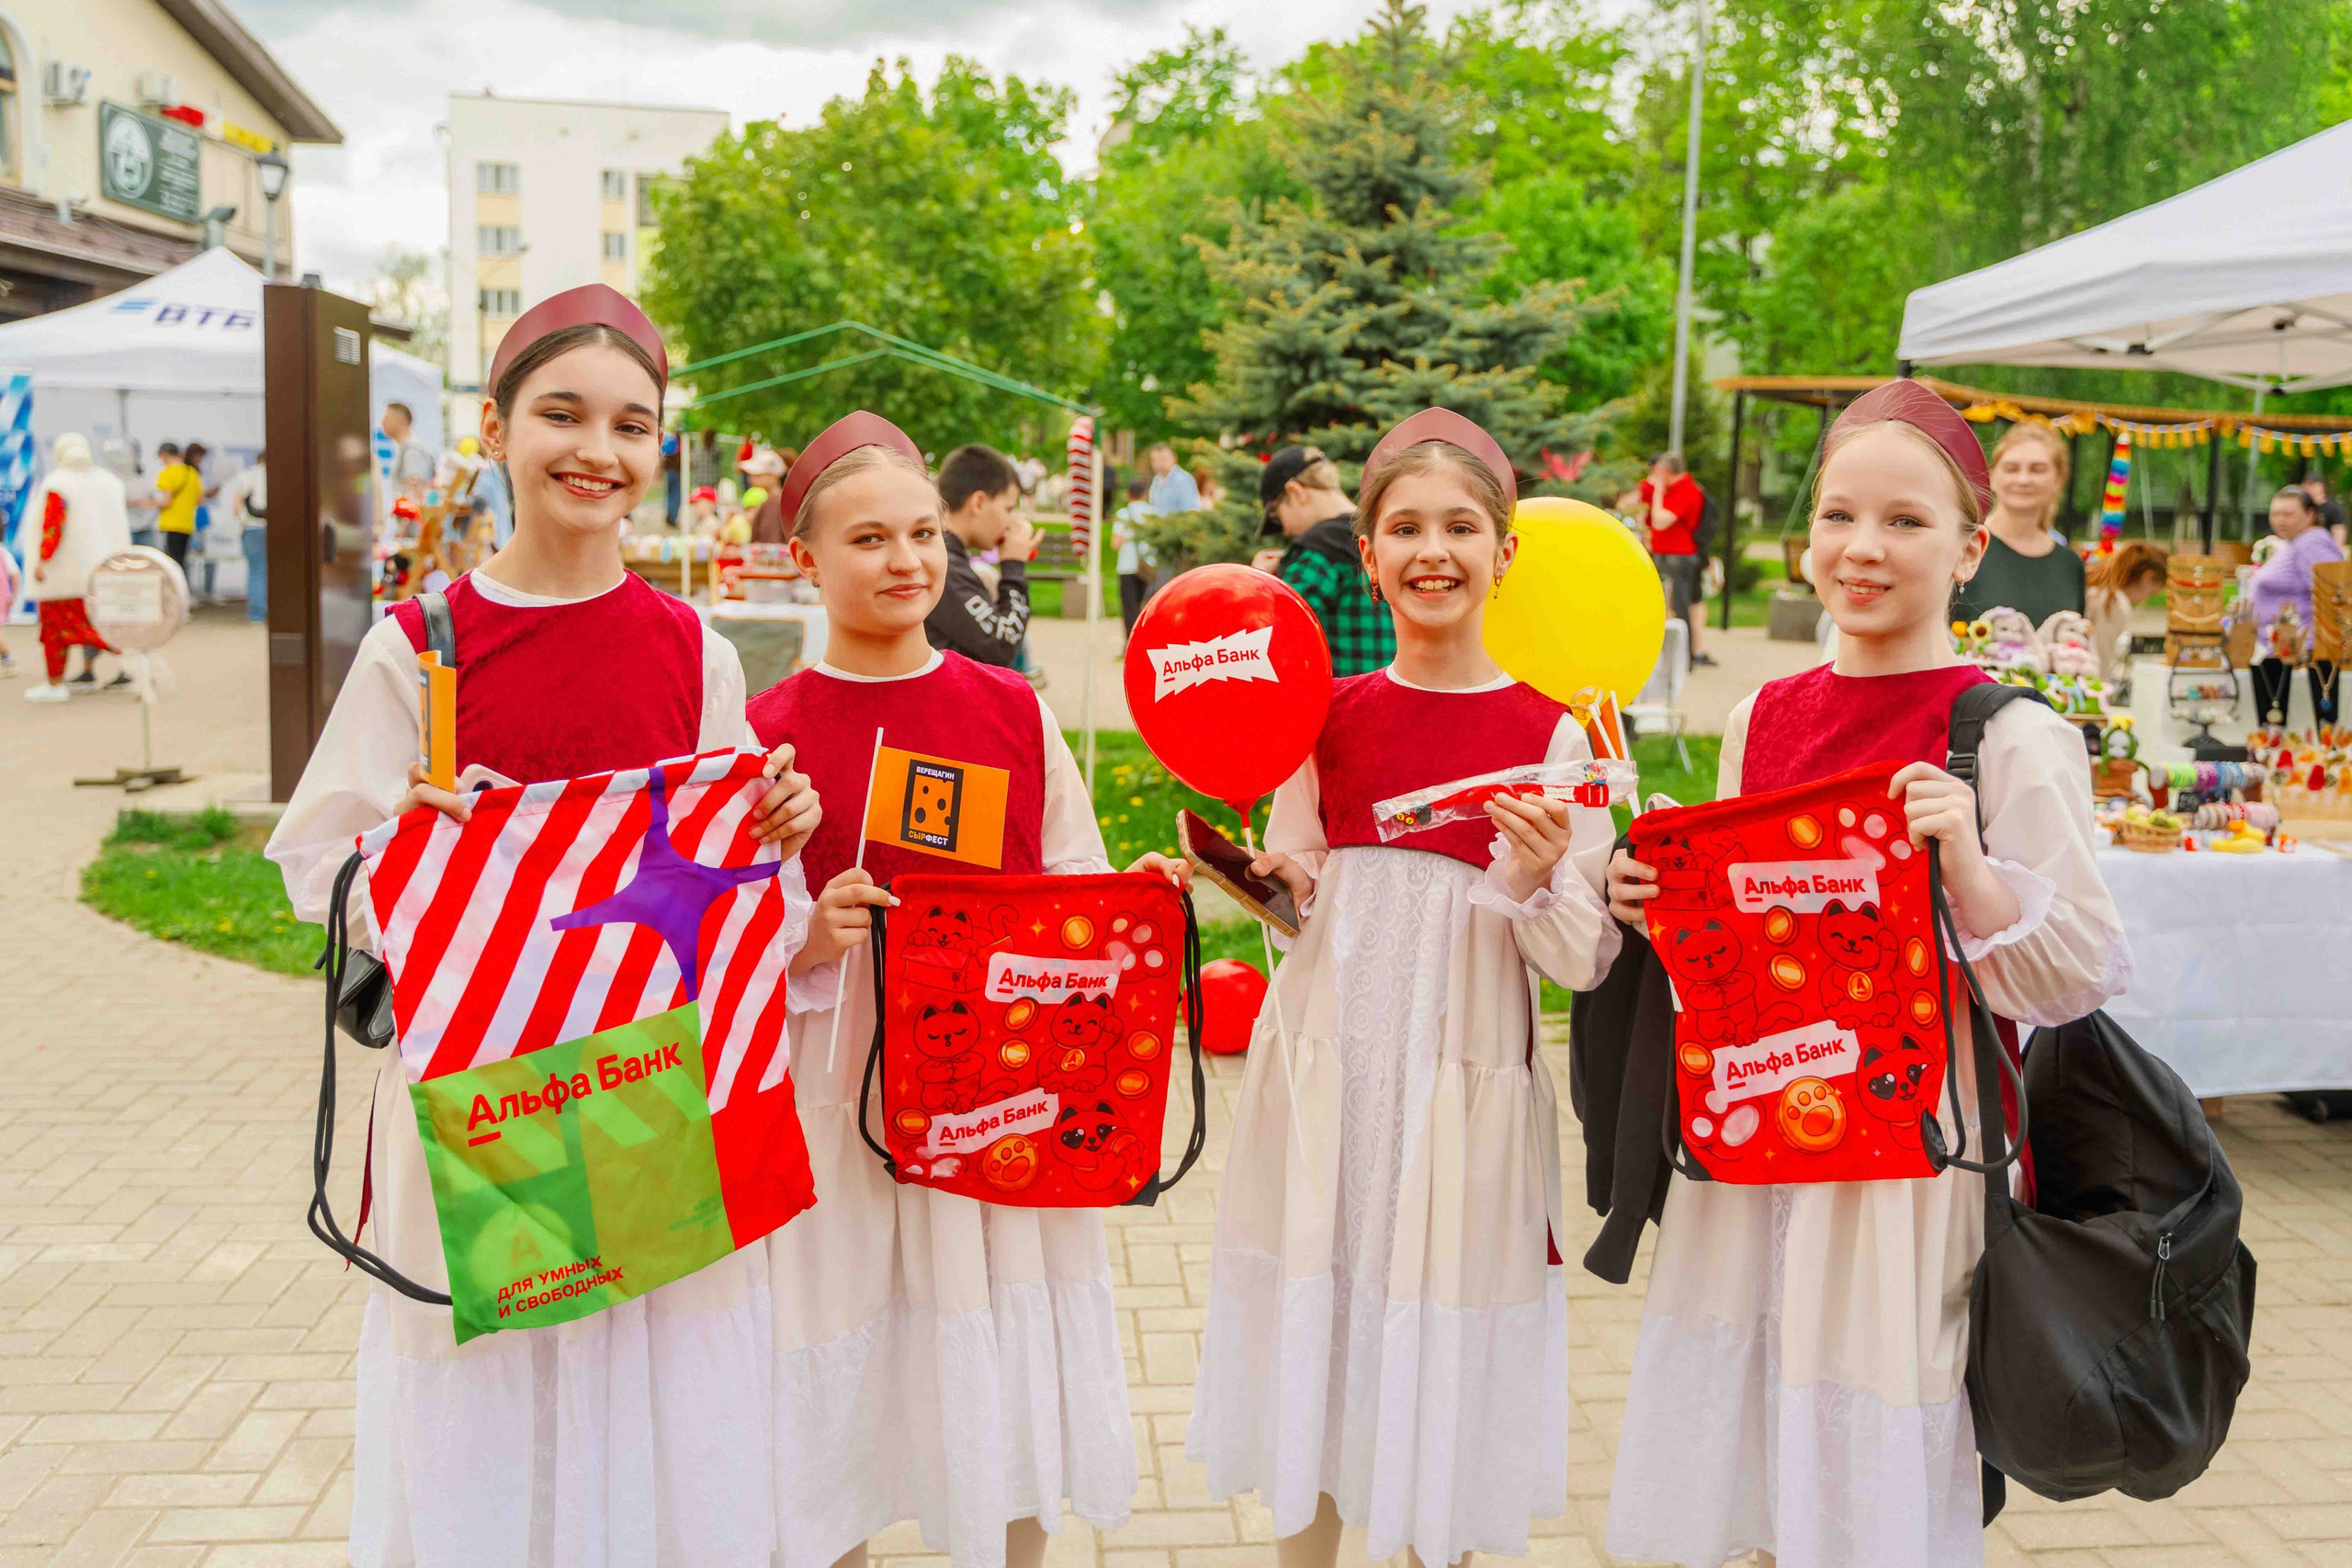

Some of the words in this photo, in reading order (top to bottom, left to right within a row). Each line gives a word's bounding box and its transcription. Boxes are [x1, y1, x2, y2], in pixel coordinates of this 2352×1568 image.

[153, 302, 256, 331] ВТБ
[1163, 653, 1214, 682] Альфа
[1217, 649, 1261, 664] Банк
[916, 765, 956, 780] ВЕРЕЩАГИН
[908, 829, 948, 846] СЫРФЕСТ
[1744, 875, 1810, 903] Альфа
[1812, 874, 1866, 894] Банк
[997, 967, 1062, 994] Альфа
[1065, 972, 1109, 989] Банк
[1726, 1051, 1795, 1090] Альфа
[1795, 1038, 1847, 1064] Банк
[468, 1072, 593, 1147] Альфа
[596, 1042, 684, 1091] Банк
[939, 1118, 1001, 1146] Альфа
[1003, 1100, 1048, 1124] Банк
[497, 1277, 534, 1304] ДЛЯ
[537, 1255, 604, 1285] УМНЫХ
[498, 1304, 511, 1319] И
[515, 1266, 624, 1313] СВОБОДНЫХ
